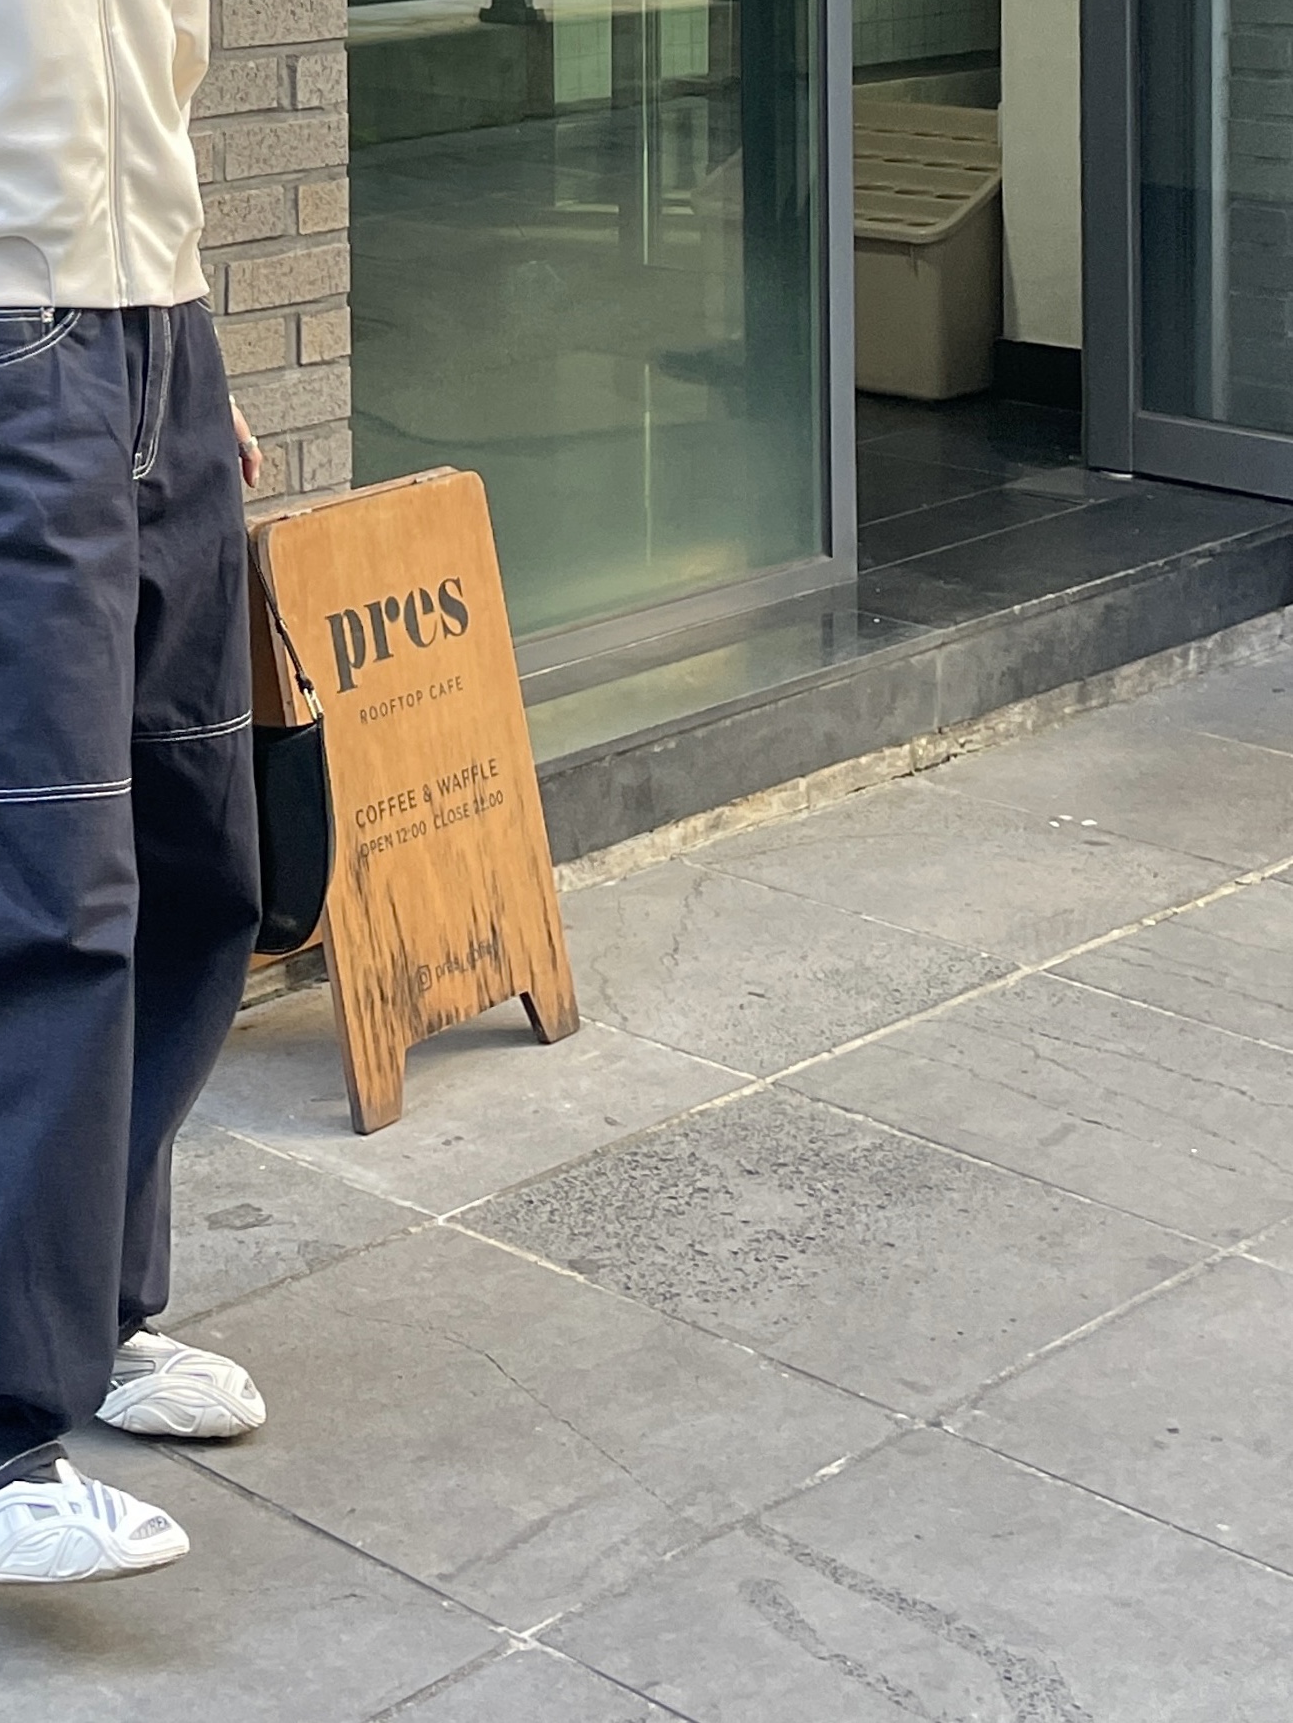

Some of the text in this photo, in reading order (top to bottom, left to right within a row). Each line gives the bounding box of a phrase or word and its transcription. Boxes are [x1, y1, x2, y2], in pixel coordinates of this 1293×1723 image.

[325, 576, 469, 694] pres
[360, 675, 464, 724] ROOFTOP CAFE
[355, 758, 499, 829] COFFEE & WAFFLE
[359, 832, 395, 859] OPEN
[433, 802, 470, 830] CLOSE
